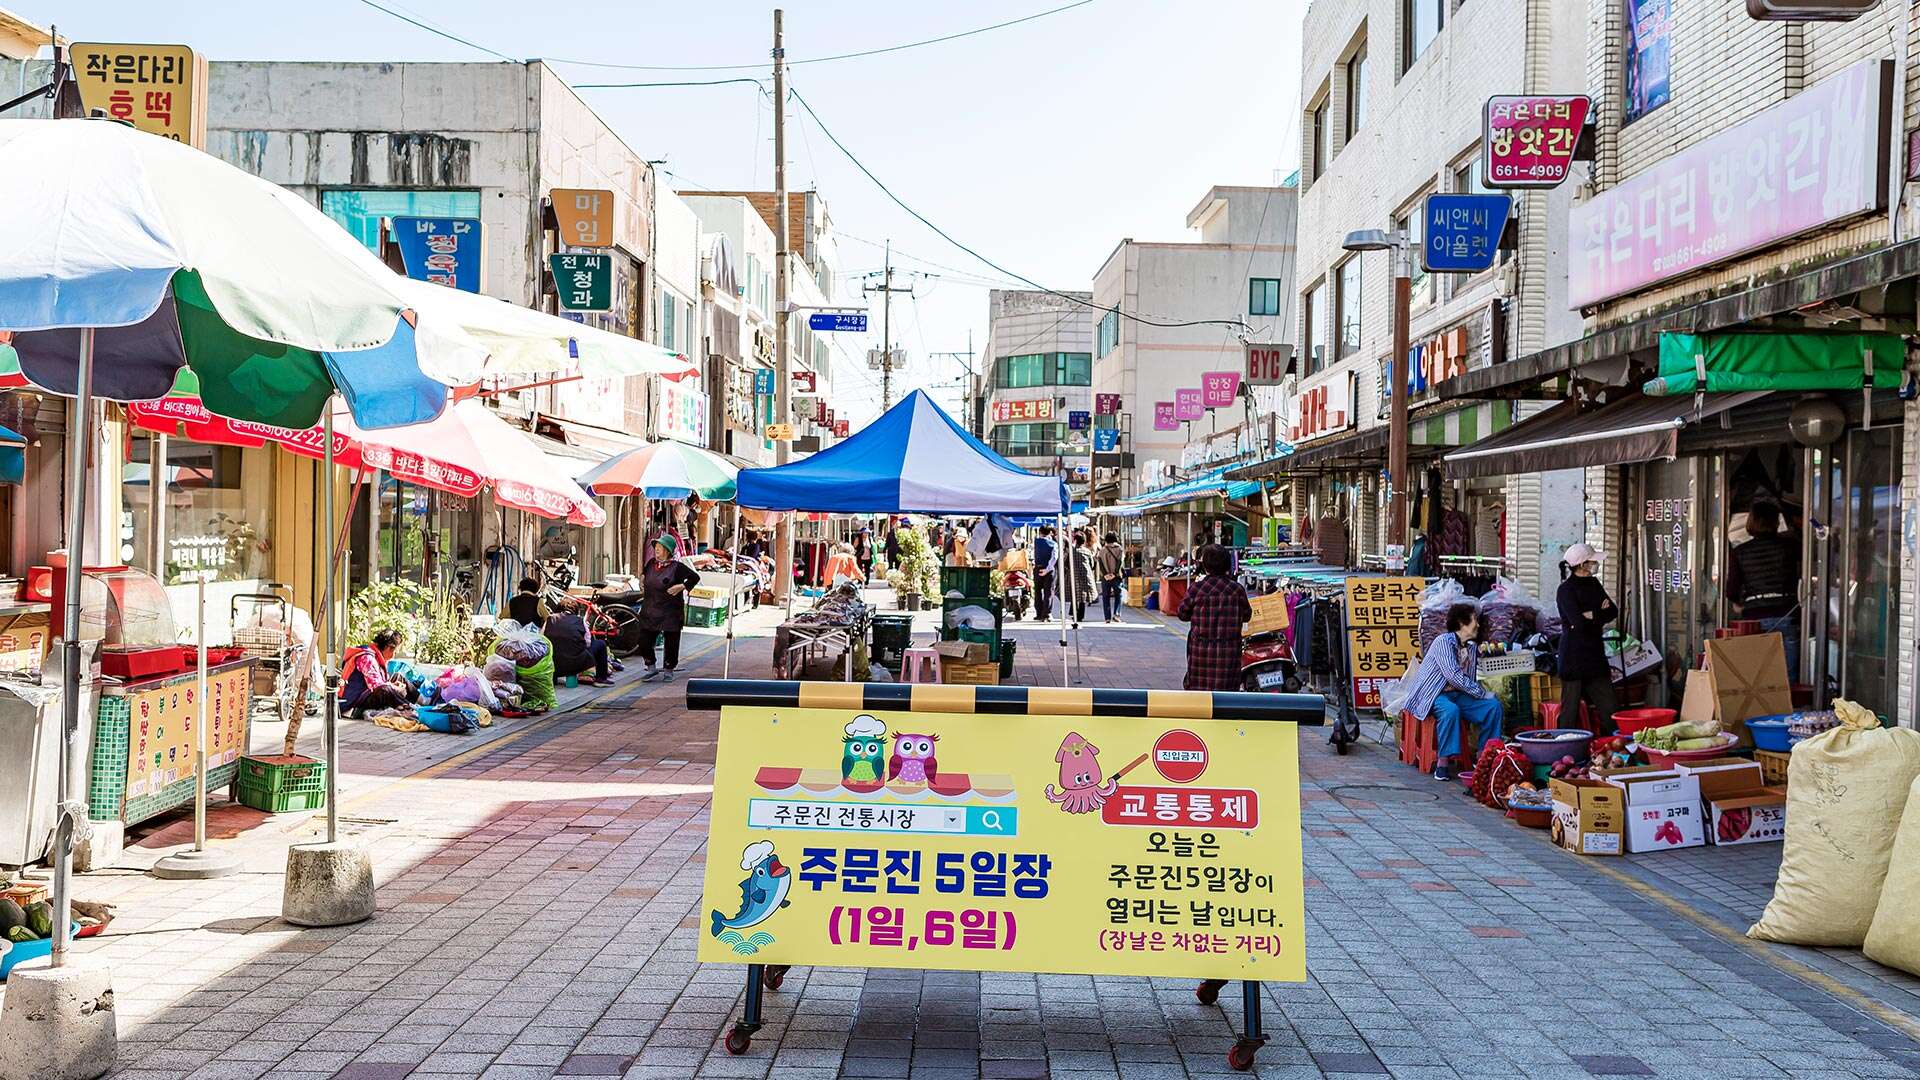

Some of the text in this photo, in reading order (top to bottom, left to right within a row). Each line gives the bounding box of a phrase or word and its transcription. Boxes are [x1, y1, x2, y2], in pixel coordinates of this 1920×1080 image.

[86, 54, 184, 84] 작은다리
[1494, 103, 1571, 121] 작은다리
[1490, 127, 1575, 157] 방앗간
[1495, 165, 1564, 177] 661-4909
[1582, 107, 1827, 270] 작은다리 방앗간
[415, 219, 472, 234] 바다
[1433, 207, 1489, 231] 씨앤씨
[1433, 235, 1489, 258] 아울렛
[571, 270, 594, 308] 청과
[835, 315, 866, 325] 구시장길
[1249, 349, 1280, 380] BYC
[1208, 377, 1232, 390] 광장
[1208, 390, 1232, 402] 마트
[1010, 400, 1051, 419] 노래방
[1299, 384, 1328, 438] BYC
[1352, 583, 1421, 602] 손칼국수
[1354, 606, 1421, 625] 떡만두국
[1161, 751, 1201, 762] 진입금지
[773, 804, 916, 830] 주문진 전통시장
[1119, 793, 1248, 823] 교통통제
[1146, 832, 1221, 858] 오늘은
[798, 847, 1053, 900] 주문진 5일장
[1107, 864, 1274, 894] 주문진5일장이
[1105, 897, 1182, 926] 열리는
[828, 905, 1018, 951] (1일,6일)
[1099, 928, 1282, 957] (장날은 차없는 거리)
